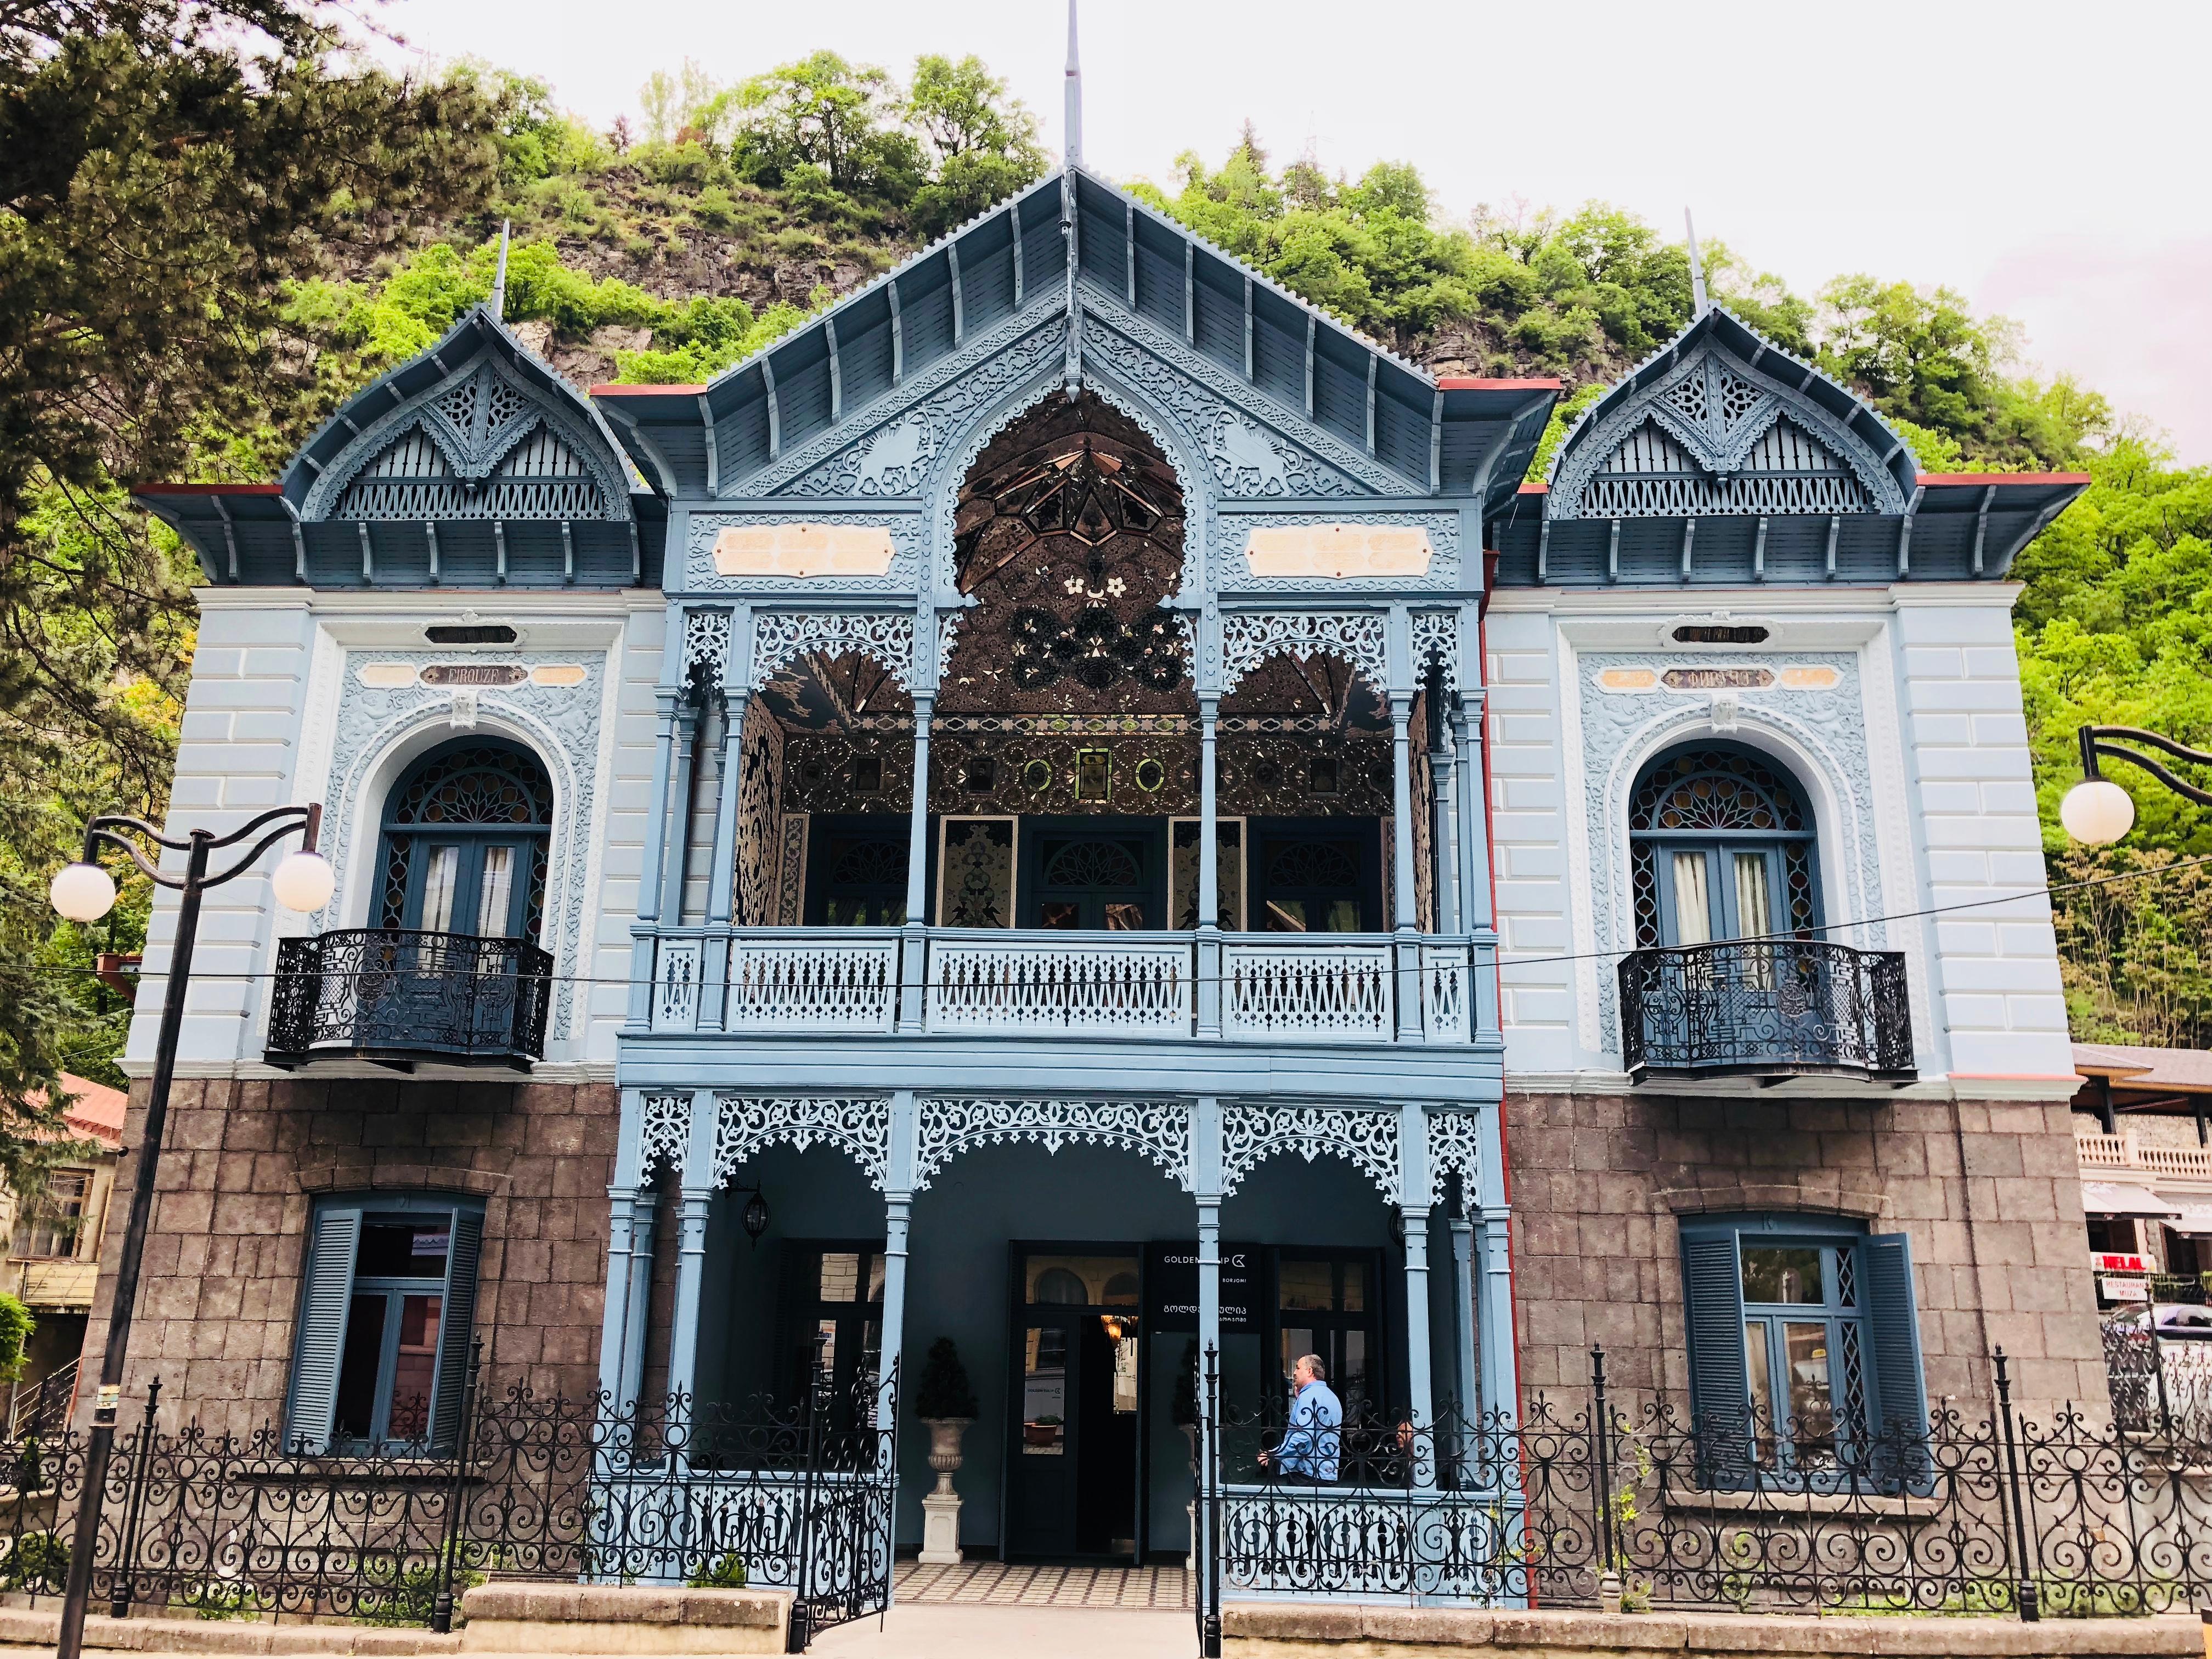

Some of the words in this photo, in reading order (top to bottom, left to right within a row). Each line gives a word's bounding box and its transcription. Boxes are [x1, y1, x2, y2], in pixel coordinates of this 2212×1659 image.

[448, 668, 499, 684] FIROUZE
[1164, 1305, 1200, 1313] გოლდ
[1219, 1306, 1246, 1314] ულიპ
